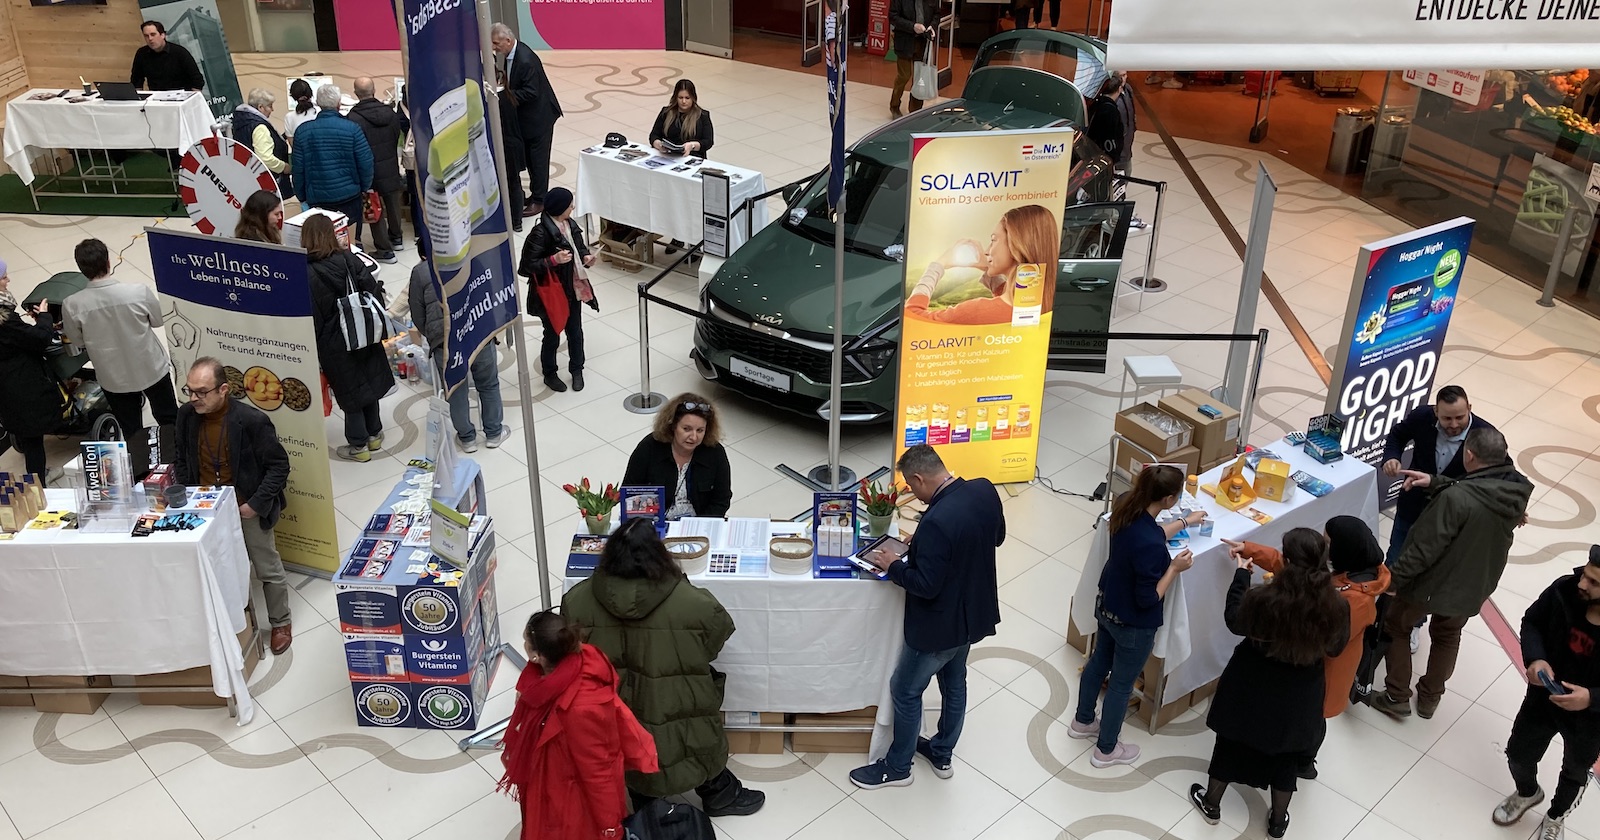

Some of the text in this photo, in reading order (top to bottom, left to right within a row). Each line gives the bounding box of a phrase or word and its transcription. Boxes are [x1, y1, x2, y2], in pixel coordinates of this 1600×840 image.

[201, 164, 243, 210] ekend
[919, 190, 1057, 205] Vitamin D3 clever kombiniert
[1399, 242, 1443, 262] Hoggar Night
[171, 251, 289, 280] the wellness co.
[1440, 251, 1459, 267] NEU!
[190, 270, 272, 292] Leben in Balance
[985, 335, 1022, 345] Osteo
[217, 341, 302, 363] Tees und Arzneitees
[916, 352, 942, 361] Vitamin
[915, 357, 989, 369] für gesunde Knochen
[744, 366, 775, 382] Sportage
[938, 368, 962, 377] täglich
[915, 378, 956, 388] Unabhängig
[971, 375, 985, 383] den
[1340, 351, 1436, 415] GOOD
[1310, 415, 1327, 426] GOOD
[1340, 388, 1429, 452] NIGHT
[289, 487, 325, 500] Österreich
[423, 603, 436, 612] 50
[416, 622, 447, 631] Jubiläum
[411, 651, 461, 661] Burgerstein
[418, 661, 458, 669] Vitamine
[377, 698, 390, 706] 50
